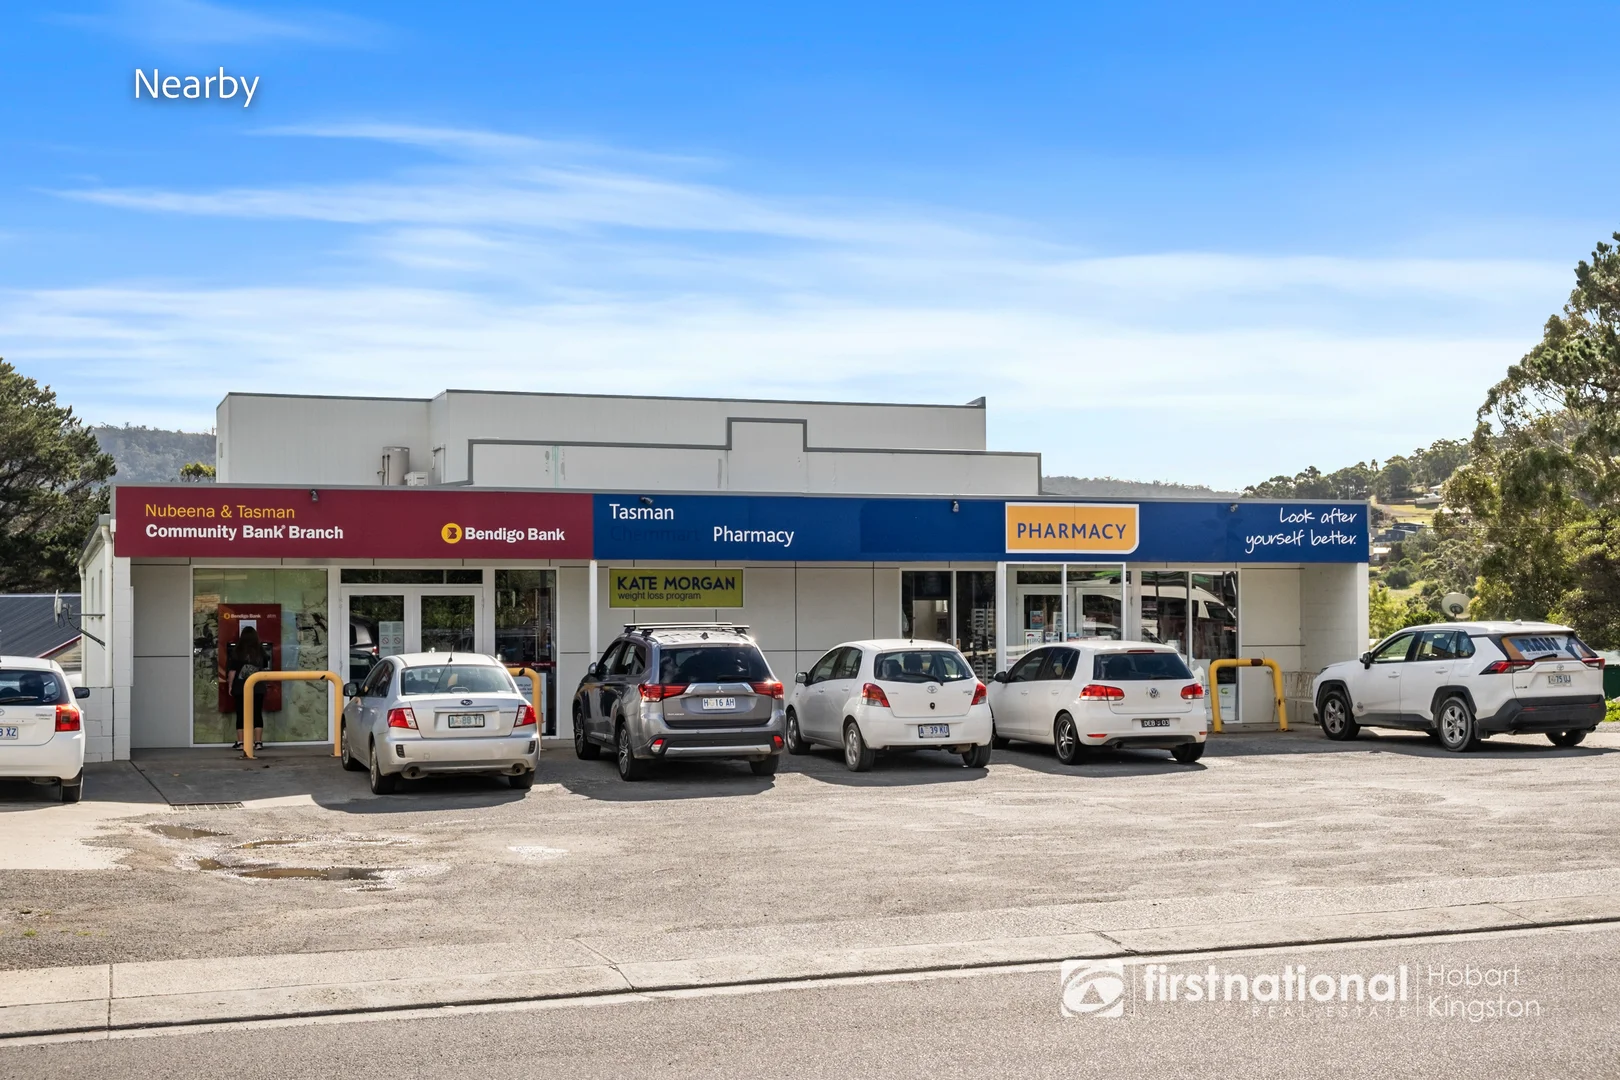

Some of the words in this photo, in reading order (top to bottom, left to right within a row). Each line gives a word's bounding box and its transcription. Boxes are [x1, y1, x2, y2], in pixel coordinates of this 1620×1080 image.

[145, 504, 215, 518] Nubeena
[220, 505, 232, 518] &
[237, 505, 295, 519] Tasman
[609, 503, 674, 520] Tasman
[1280, 507, 1315, 523] Look
[1320, 507, 1357, 524] after
[145, 523, 237, 541] Community
[288, 525, 344, 539] Branch
[465, 527, 525, 543] Bendigo
[527, 527, 566, 541] Bank
[713, 525, 795, 548] Pharmacy
[1017, 522, 1127, 540] PHARMACY
[1245, 529, 1305, 554] yourself
[1310, 529, 1357, 546] better.
[617, 576, 657, 590] KATE
[663, 576, 736, 590] MORGAN
[617, 592, 646, 601] weight
[647, 592, 664, 600] loss
[665, 593, 701, 601] program
[1519, 637, 1562, 652] RAW
[6, 728, 16, 737] XZ
